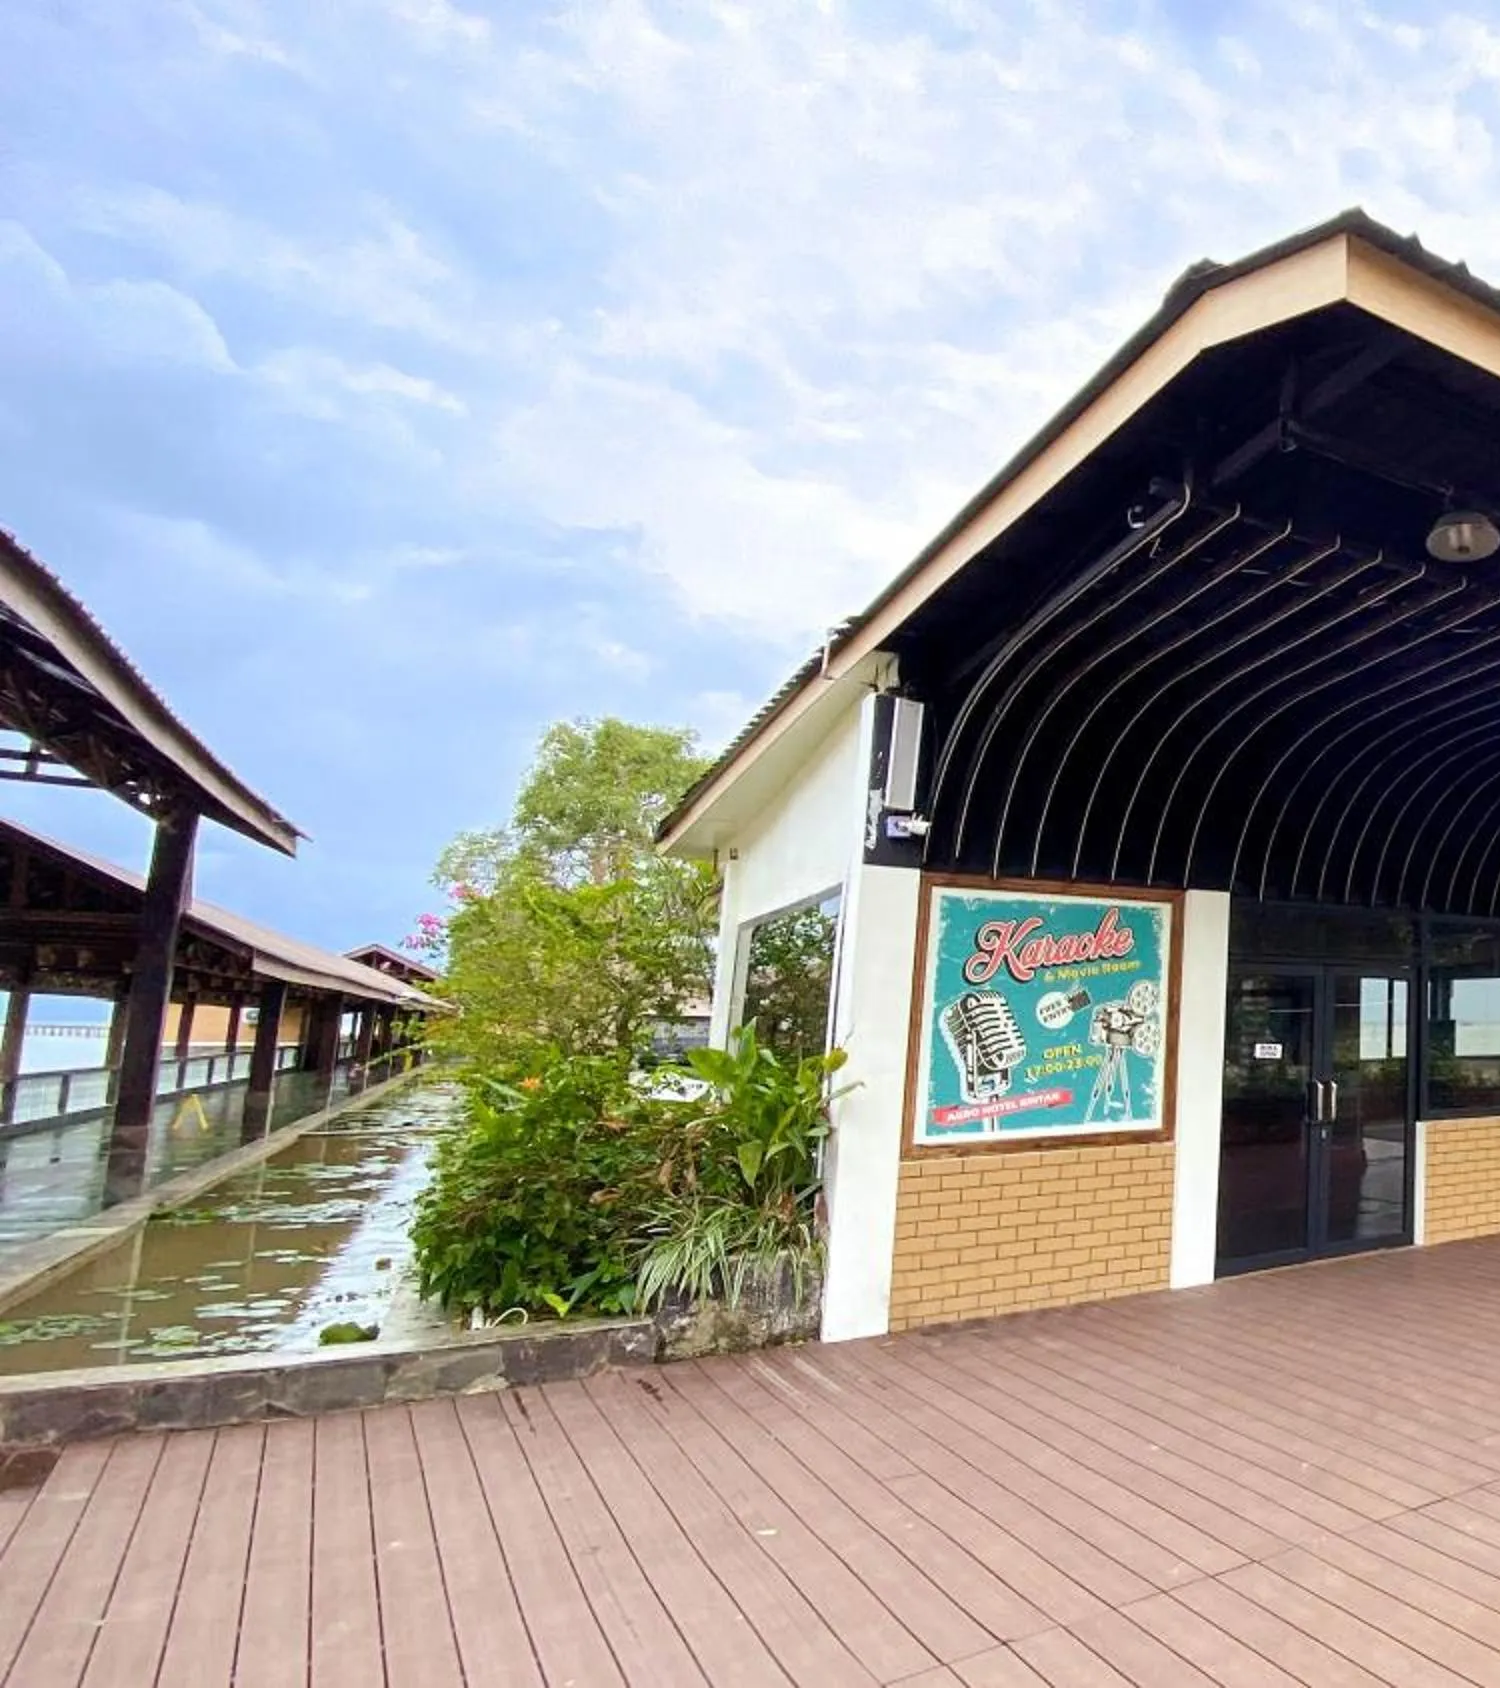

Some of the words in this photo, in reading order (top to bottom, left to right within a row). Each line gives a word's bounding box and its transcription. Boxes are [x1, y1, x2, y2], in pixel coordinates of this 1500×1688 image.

[964, 907, 1134, 984] Karaoke
[1056, 966, 1100, 980] Movie
[1102, 960, 1141, 974] Room
[1043, 1044, 1082, 1059] OPEN
[982, 1101, 1018, 1115] HOTEL
